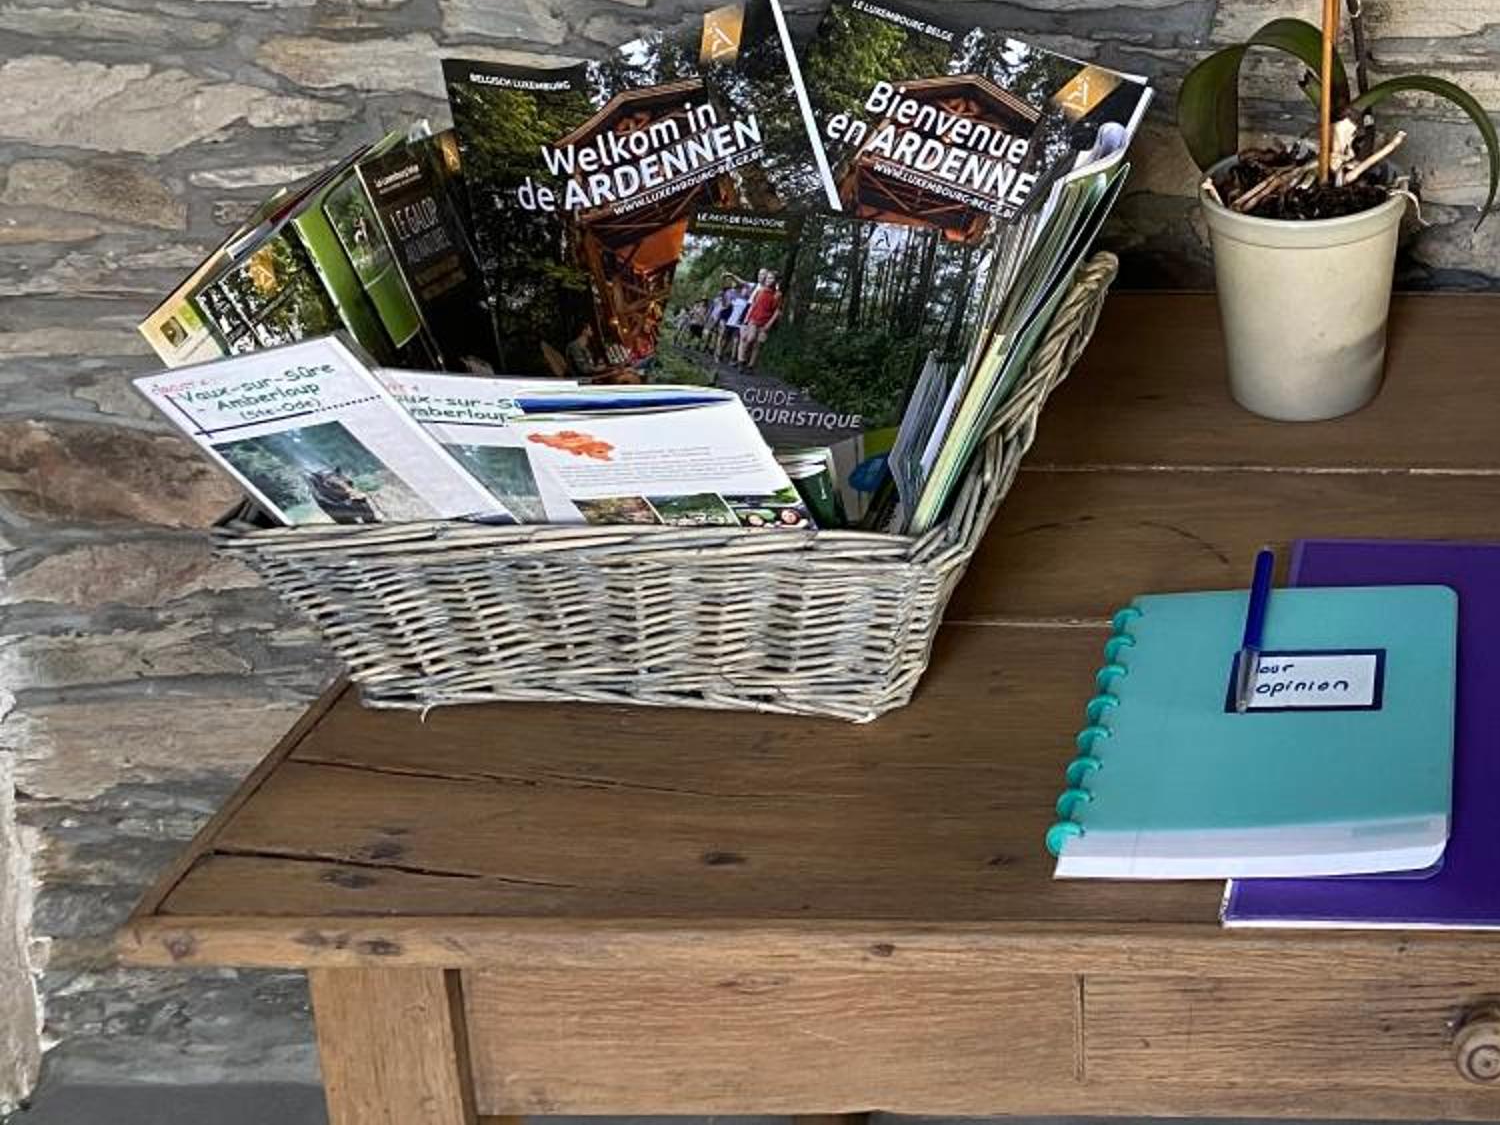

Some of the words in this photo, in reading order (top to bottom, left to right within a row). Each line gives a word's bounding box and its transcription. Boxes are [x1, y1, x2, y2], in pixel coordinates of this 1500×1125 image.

[864, 3, 925, 32] LUXEMBOURG
[925, 24, 955, 42] BELGE
[541, 117, 680, 176] Welkom
[685, 102, 717, 132] in
[865, 81, 1030, 164] Bienvenue
[517, 177, 555, 211] de
[564, 114, 762, 210] ARDENNEN
[827, 112, 867, 147] en
[869, 124, 1038, 206] ARDENNE
[216, 383, 319, 412] Amberloup
[743, 387, 798, 407] GUIDE
[1255, 679, 1350, 698] opinion
